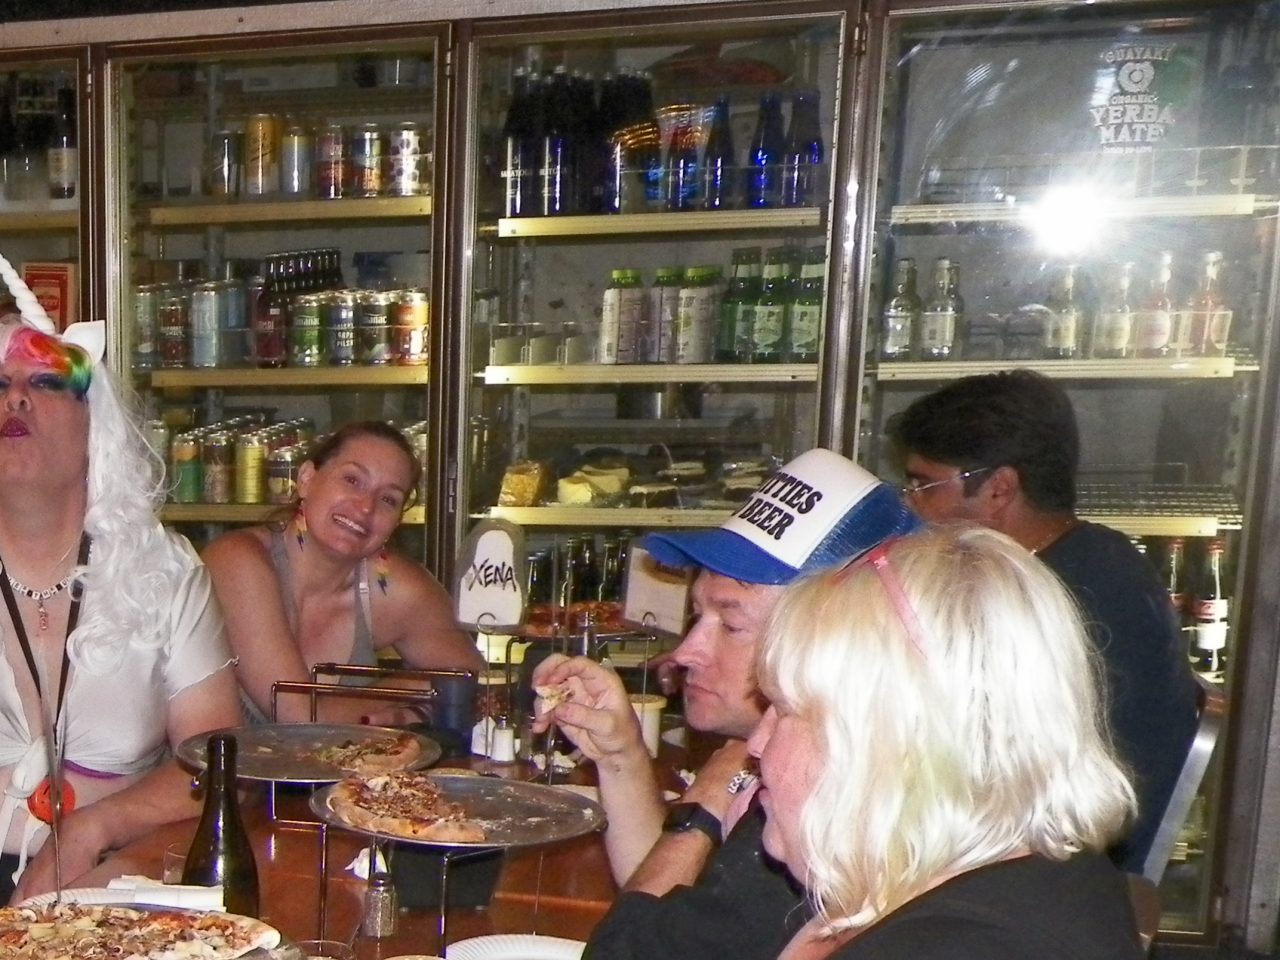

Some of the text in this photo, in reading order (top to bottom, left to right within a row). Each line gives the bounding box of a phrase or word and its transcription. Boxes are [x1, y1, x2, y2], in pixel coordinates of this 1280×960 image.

[1089, 103, 1175, 127] YERBA
[739, 498, 795, 540] BEER
[468, 557, 517, 592] XENA
